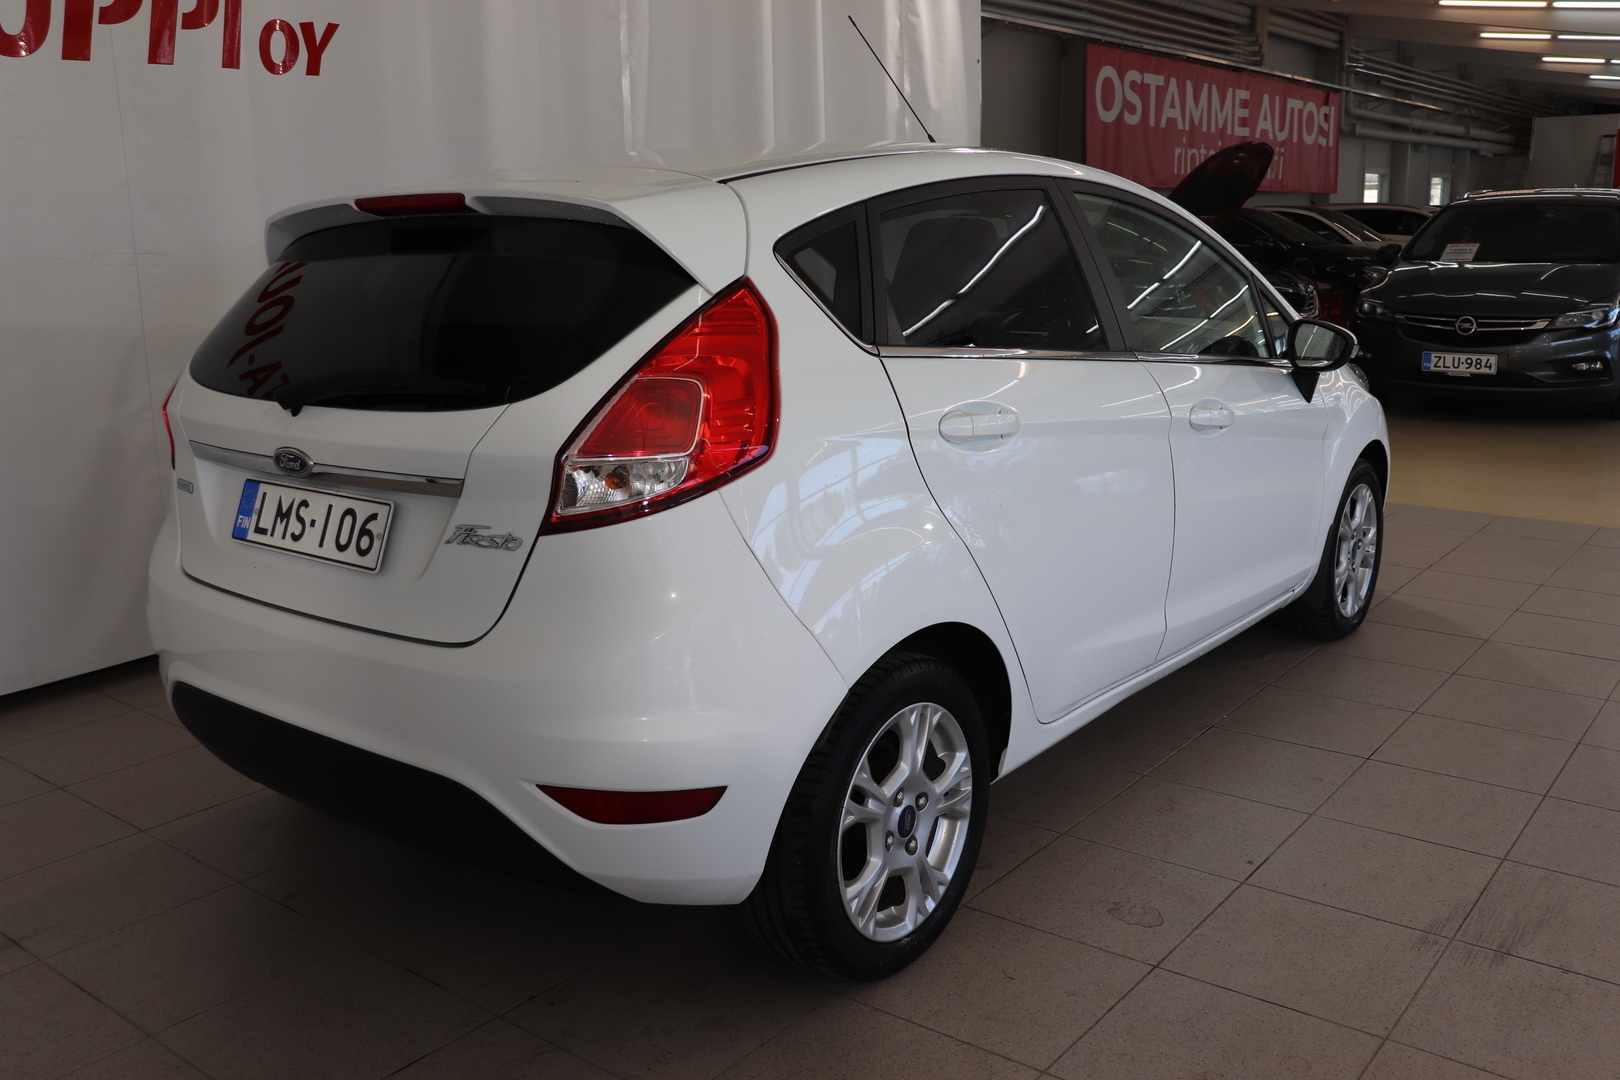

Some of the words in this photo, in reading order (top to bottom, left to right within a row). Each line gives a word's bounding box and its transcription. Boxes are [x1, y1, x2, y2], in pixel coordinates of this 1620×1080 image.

[258, 18, 341, 77] OY
[1095, 65, 1250, 137] OSTAMME
[1255, 93, 1335, 147] AUTOSI
[1433, 355, 1492, 371] ZLU-984
[279, 453, 302, 470] Ford
[236, 515, 252, 529] FIN
[254, 491, 379, 557] LMS-106
[444, 524, 524, 552] Fiesta
